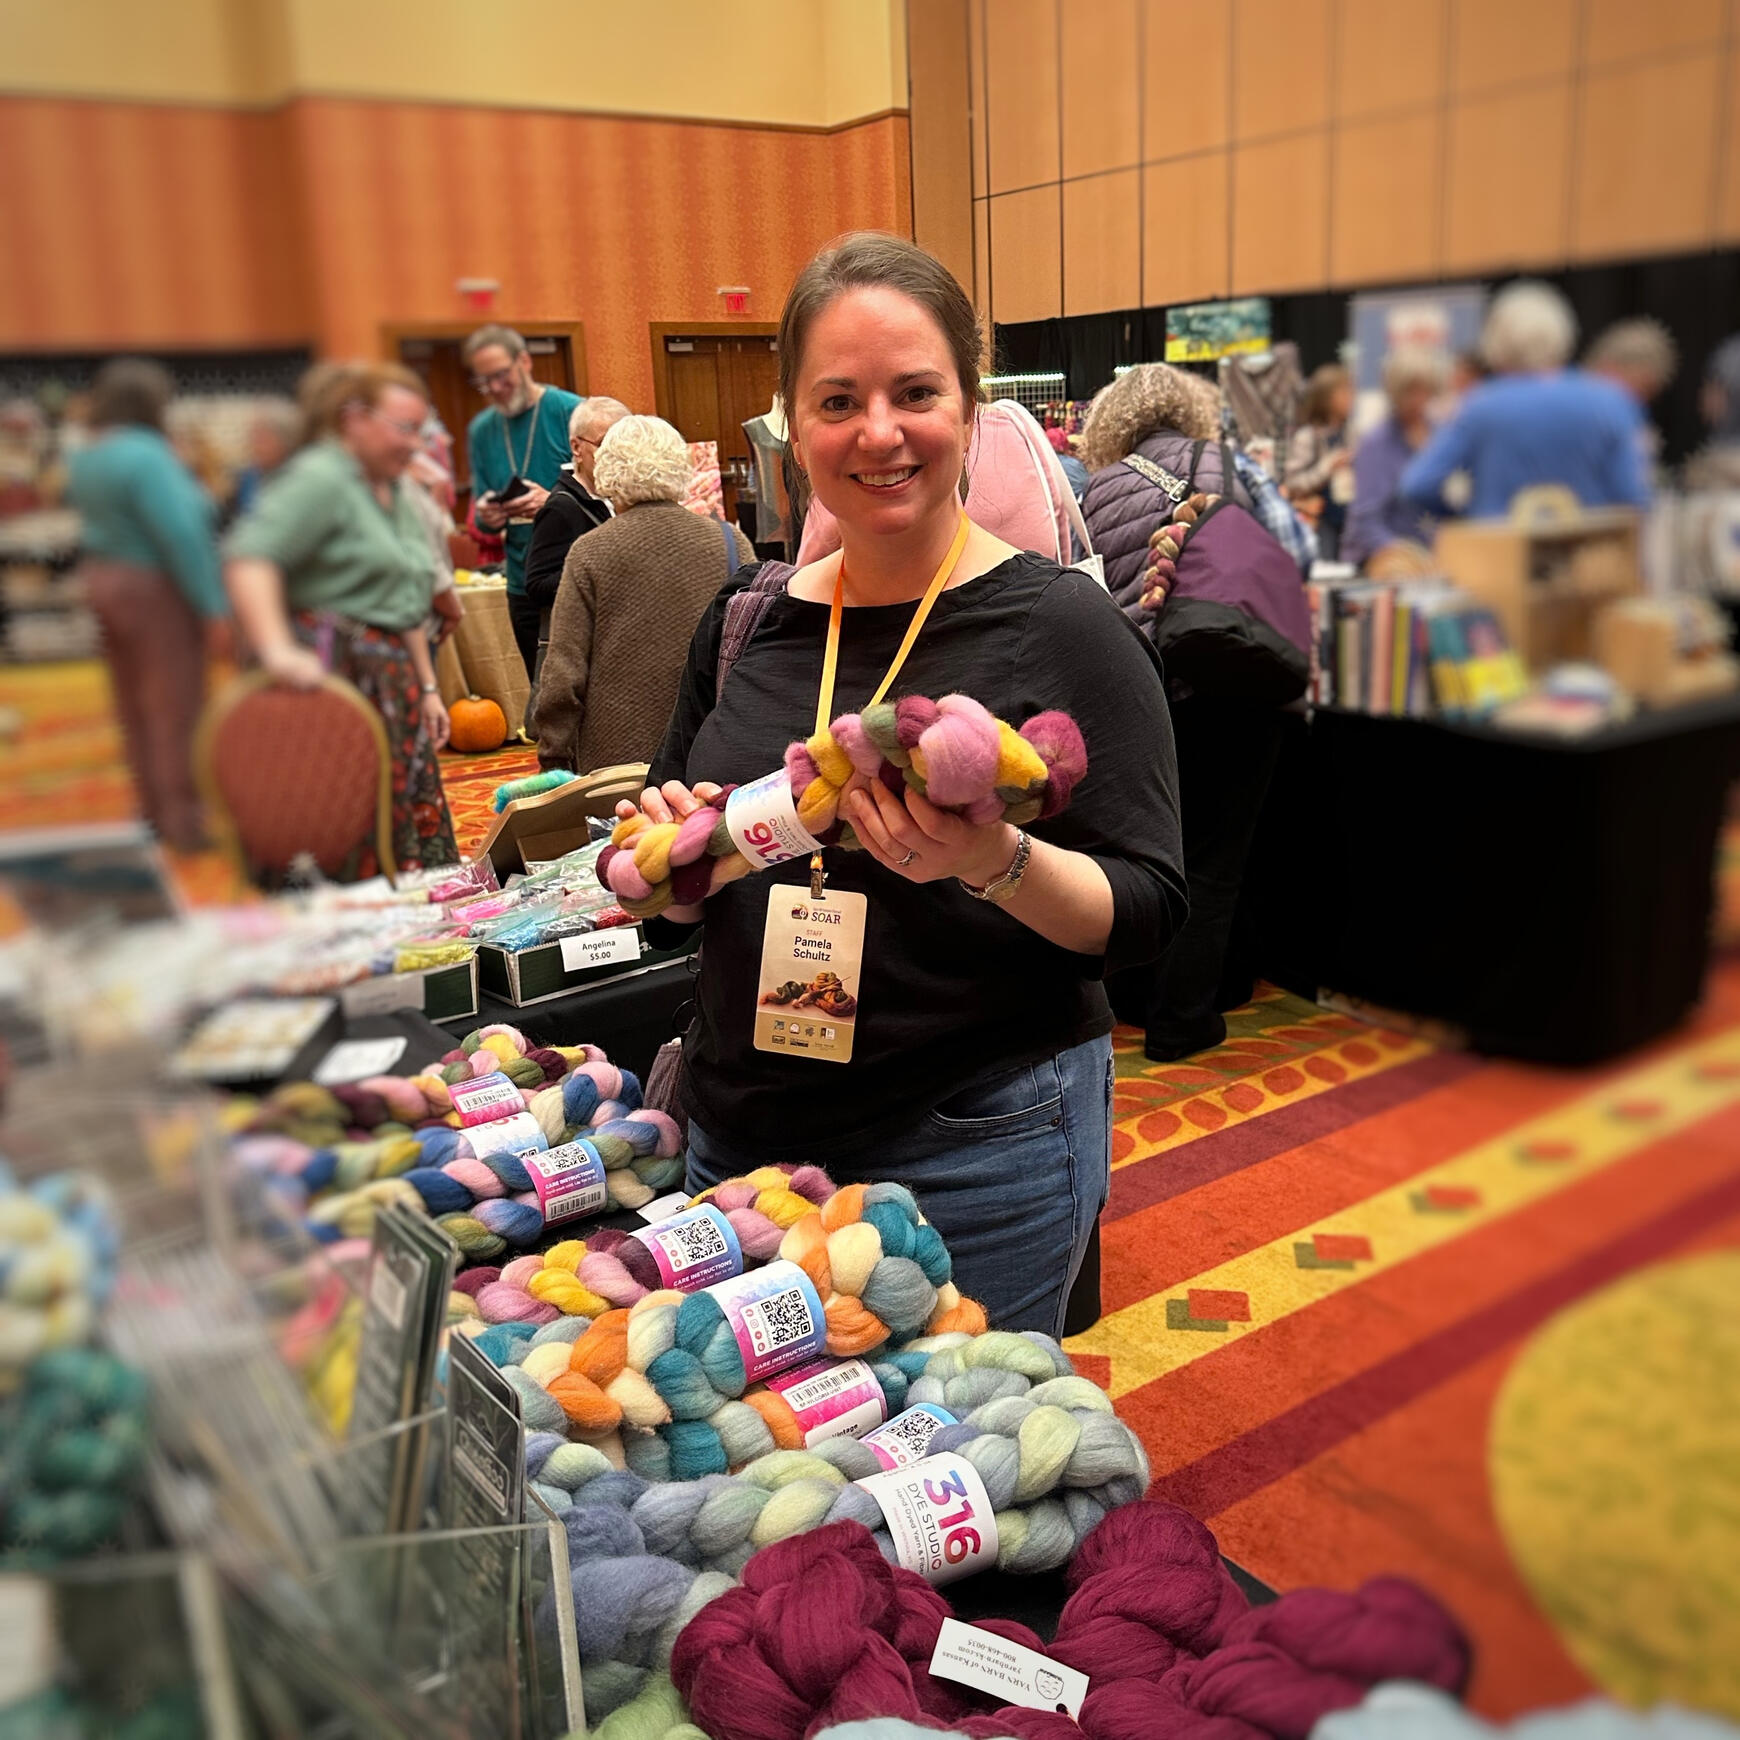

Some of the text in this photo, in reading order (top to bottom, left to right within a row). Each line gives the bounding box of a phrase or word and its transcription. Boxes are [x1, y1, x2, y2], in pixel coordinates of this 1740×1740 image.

[769, 818, 794, 849] STUDIO
[811, 911, 841, 925] SOAR
[806, 929, 823, 937] STAFF
[582, 940, 616, 951] Angelina
[794, 936, 832, 950] Pamela
[590, 951, 611, 961] $5.00
[793, 948, 831, 962] Schultz
[673, 1259, 733, 1286] CARE INSTRUCTIONS
[753, 1341, 816, 1372] CARE INSTRUCTIONS
[907, 1482, 928, 1511] DYE
[922, 1513, 942, 1570] STUDIO
[923, 1469, 981, 1565] 316
[913, 1530, 921, 1548] Yarn
[942, 1651, 1030, 1692] YARN BARN of Kansas
